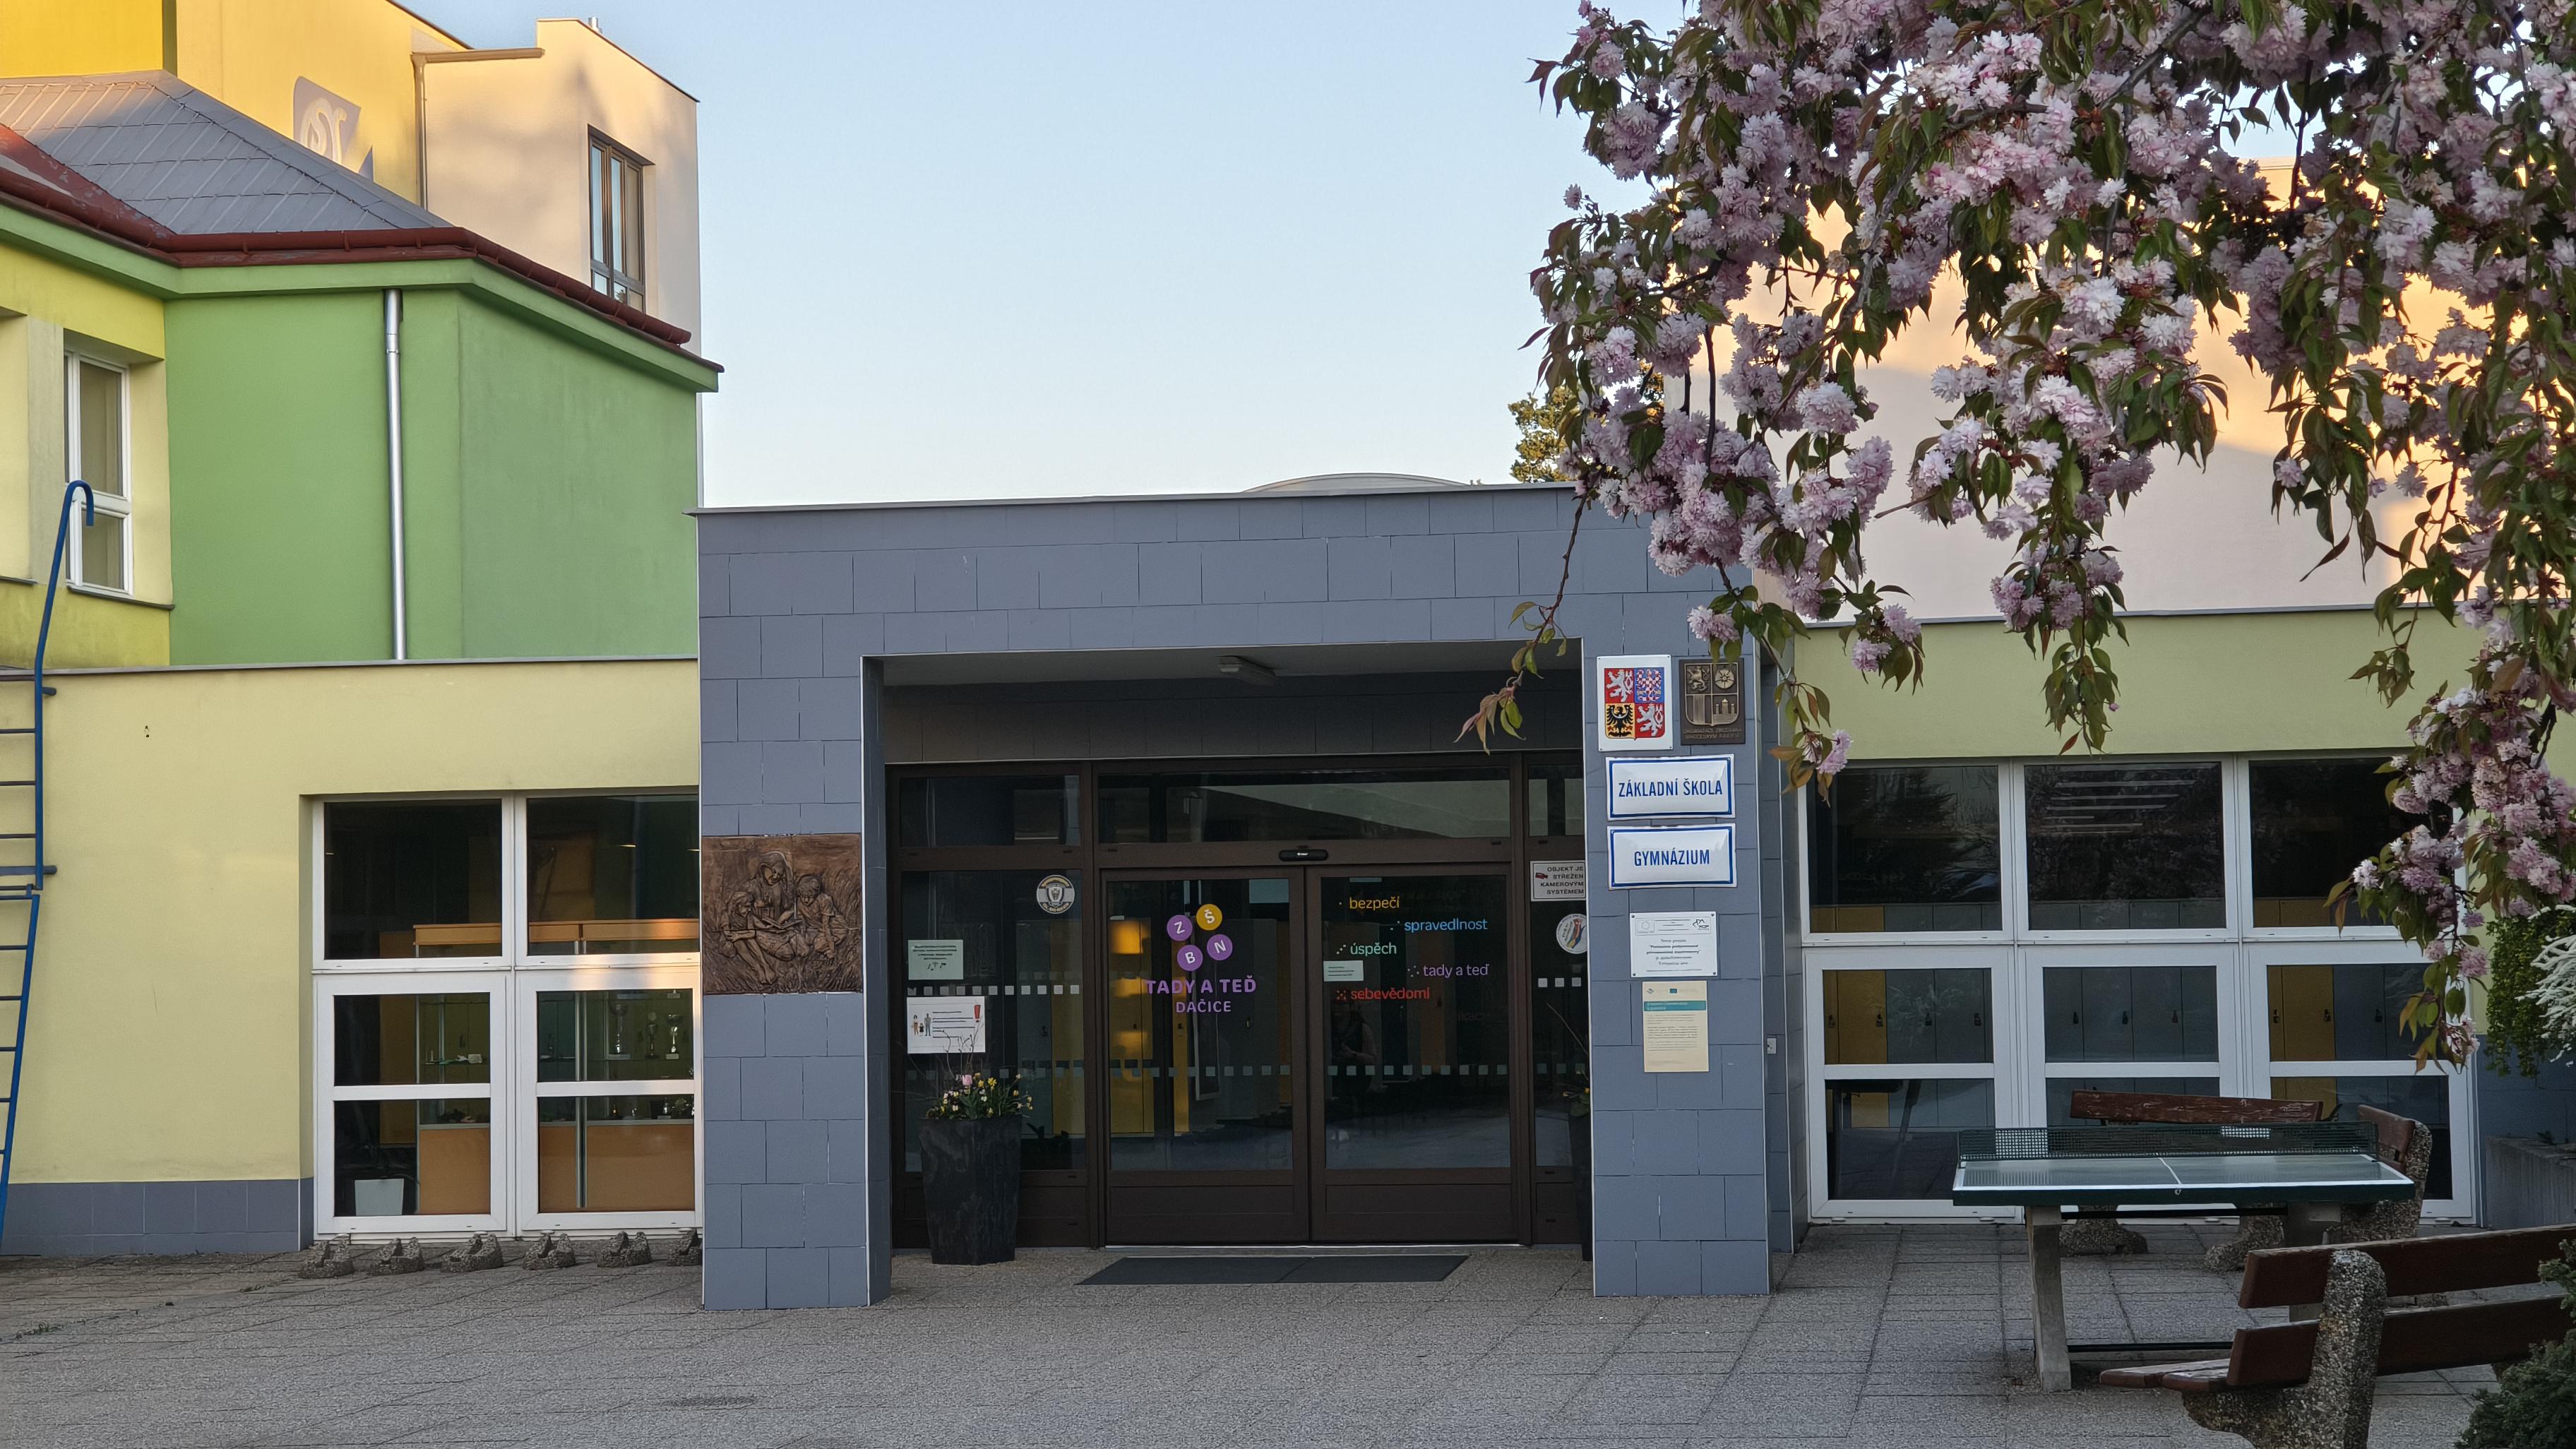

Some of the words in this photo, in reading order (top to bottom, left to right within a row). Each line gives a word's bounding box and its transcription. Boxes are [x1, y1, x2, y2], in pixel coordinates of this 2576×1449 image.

[1618, 778, 1678, 797] ZÁKLADNÍ
[1683, 777, 1723, 796] ŠKOLA
[1634, 847, 1710, 866] GYMNÁZIUM
[1349, 896, 1400, 911] bezpečí
[1174, 921, 1186, 934] Z
[1204, 908, 1215, 924] Š
[1404, 918, 1489, 933] spravedlnost
[1185, 951, 1196, 964] B
[1214, 939, 1227, 953] N
[1350, 942, 1397, 956] úspěch
[1423, 964, 1453, 978] tady
[1455, 965, 1463, 976] a
[1466, 963, 1490, 976] teď
[1145, 979, 1195, 994] TADY
[1200, 979, 1213, 994] A
[1220, 974, 1256, 994] TEĎ
[1350, 986, 1430, 1001] sebevědomí
[1176, 998, 1232, 1013] DAČICE
